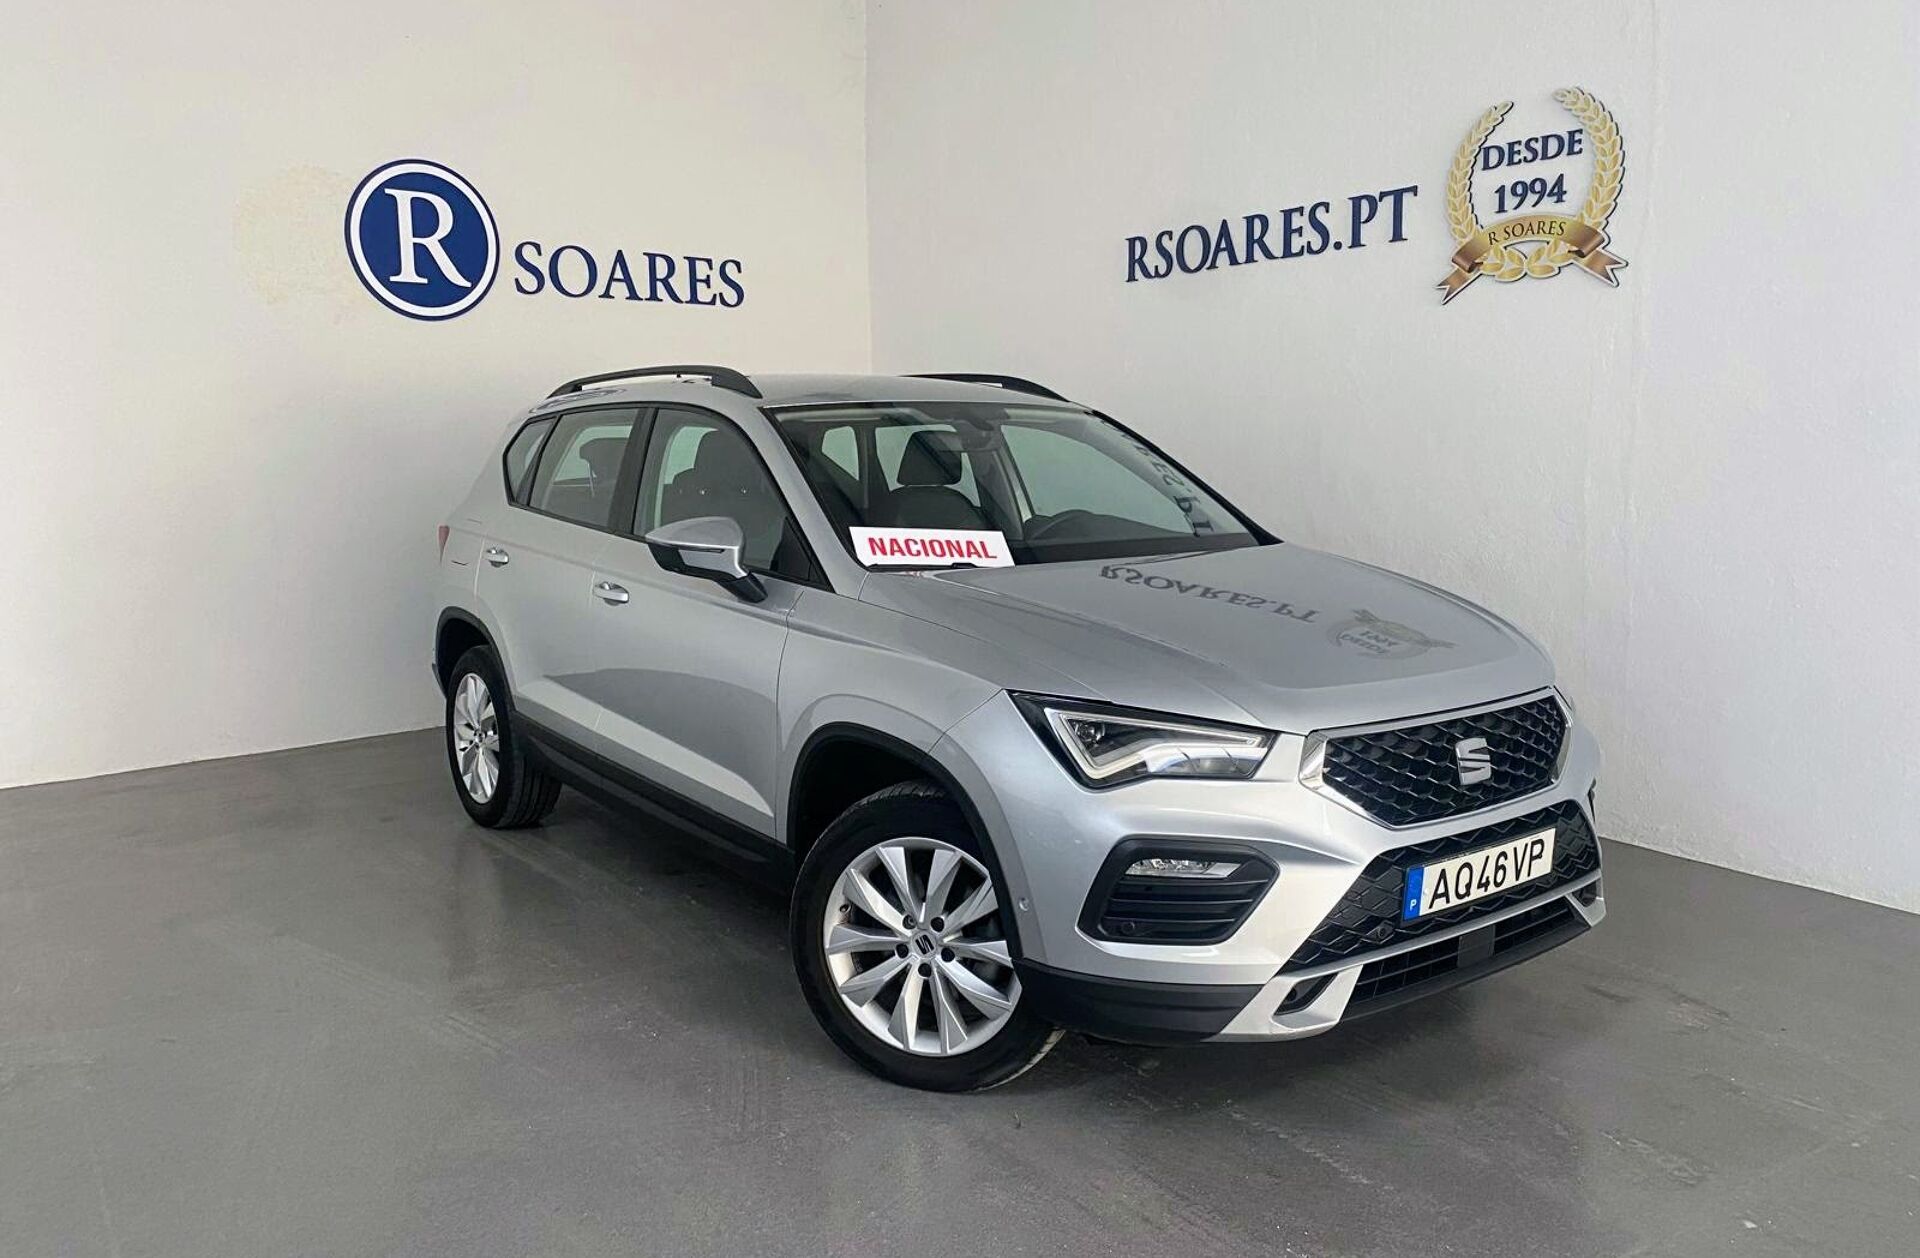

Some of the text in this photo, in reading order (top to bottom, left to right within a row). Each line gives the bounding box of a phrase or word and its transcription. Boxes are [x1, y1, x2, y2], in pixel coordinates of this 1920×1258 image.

[1480, 128, 1584, 171] DESDE
[1494, 173, 1567, 214] 1994
[385, 187, 745, 308] R SOARES
[1124, 184, 1418, 283] RSOARES.PT
[1488, 220, 1567, 245] R SOARES
[867, 536, 998, 560] NACIONAL
[1409, 899, 1417, 911] P
